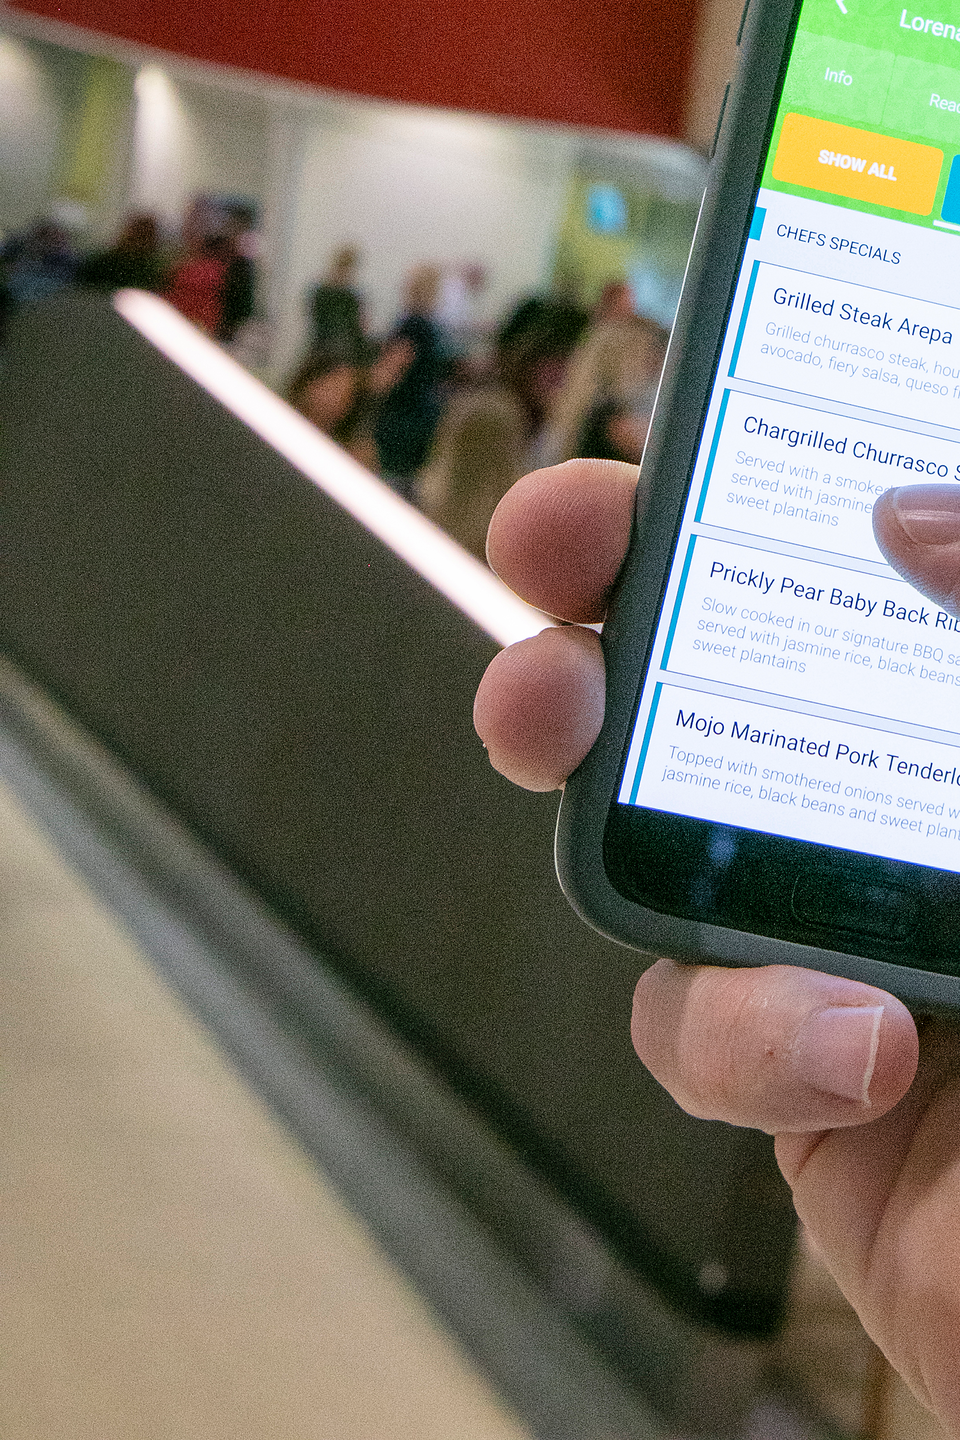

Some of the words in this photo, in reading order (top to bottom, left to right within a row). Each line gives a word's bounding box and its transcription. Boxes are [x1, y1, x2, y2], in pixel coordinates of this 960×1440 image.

[824, 66, 853, 87] Info
[817, 149, 868, 173] SHOW
[867, 161, 898, 182] ALL
[776, 223, 827, 247] CHEFS
[829, 236, 902, 265] SPECIALS
[773, 287, 835, 317] Grilled
[839, 303, 893, 331] Steak
[897, 317, 953, 345] Arepa
[760, 343, 823, 369] avocado,
[828, 355, 860, 379] fiery
[861, 366, 901, 388] salsa,
[905, 377, 949, 397] queso
[765, 321, 812, 344] Grilled
[813, 334, 885, 362] churrasco
[888, 353, 929, 374] steak,
[735, 450, 786, 474] Served
[788, 465, 819, 482] with
[822, 473, 832, 485] a
[743, 415, 848, 455] Chargrilled
[852, 440, 949, 478] Churrasco
[726, 491, 770, 512] sweet
[772, 501, 839, 527] plantains
[730, 472, 780, 493] served
[783, 485, 813, 501] with
[814, 488, 873, 514] jasmine
[709, 561, 776, 595] Prickly
[779, 576, 825, 602] Pear
[829, 587, 878, 618] Baby
[882, 599, 930, 626] Back
[692, 638, 737, 659] sweet
[739, 648, 807, 674] plantains
[696, 619, 747, 640] served
[750, 631, 780, 647] with
[781, 638, 841, 661] jasmine
[843, 649, 873, 670] rice,
[877, 655, 916, 677] black
[701, 596, 738, 617] Slow
[740, 608, 795, 630] cooked
[797, 617, 811, 633] in
[814, 624, 840, 639] our
[841, 630, 909, 655] signature
[912, 642, 944, 664] BBQ
[675, 709, 725, 738] Mojo
[730, 721, 831, 758] Marinated
[835, 743, 880, 769] Pork
[660, 768, 721, 790] jasmine
[724, 781, 754, 800] rice,
[758, 785, 798, 806] black
[800, 793, 846, 817] beans
[848, 807, 878, 823] and
[879, 814, 923, 833] sweet
[669, 744, 724, 770] Topped
[727, 760, 758, 777] with
[761, 768, 842, 795] smothered
[843, 785, 893, 806] onions
[895, 796, 945, 817] served
